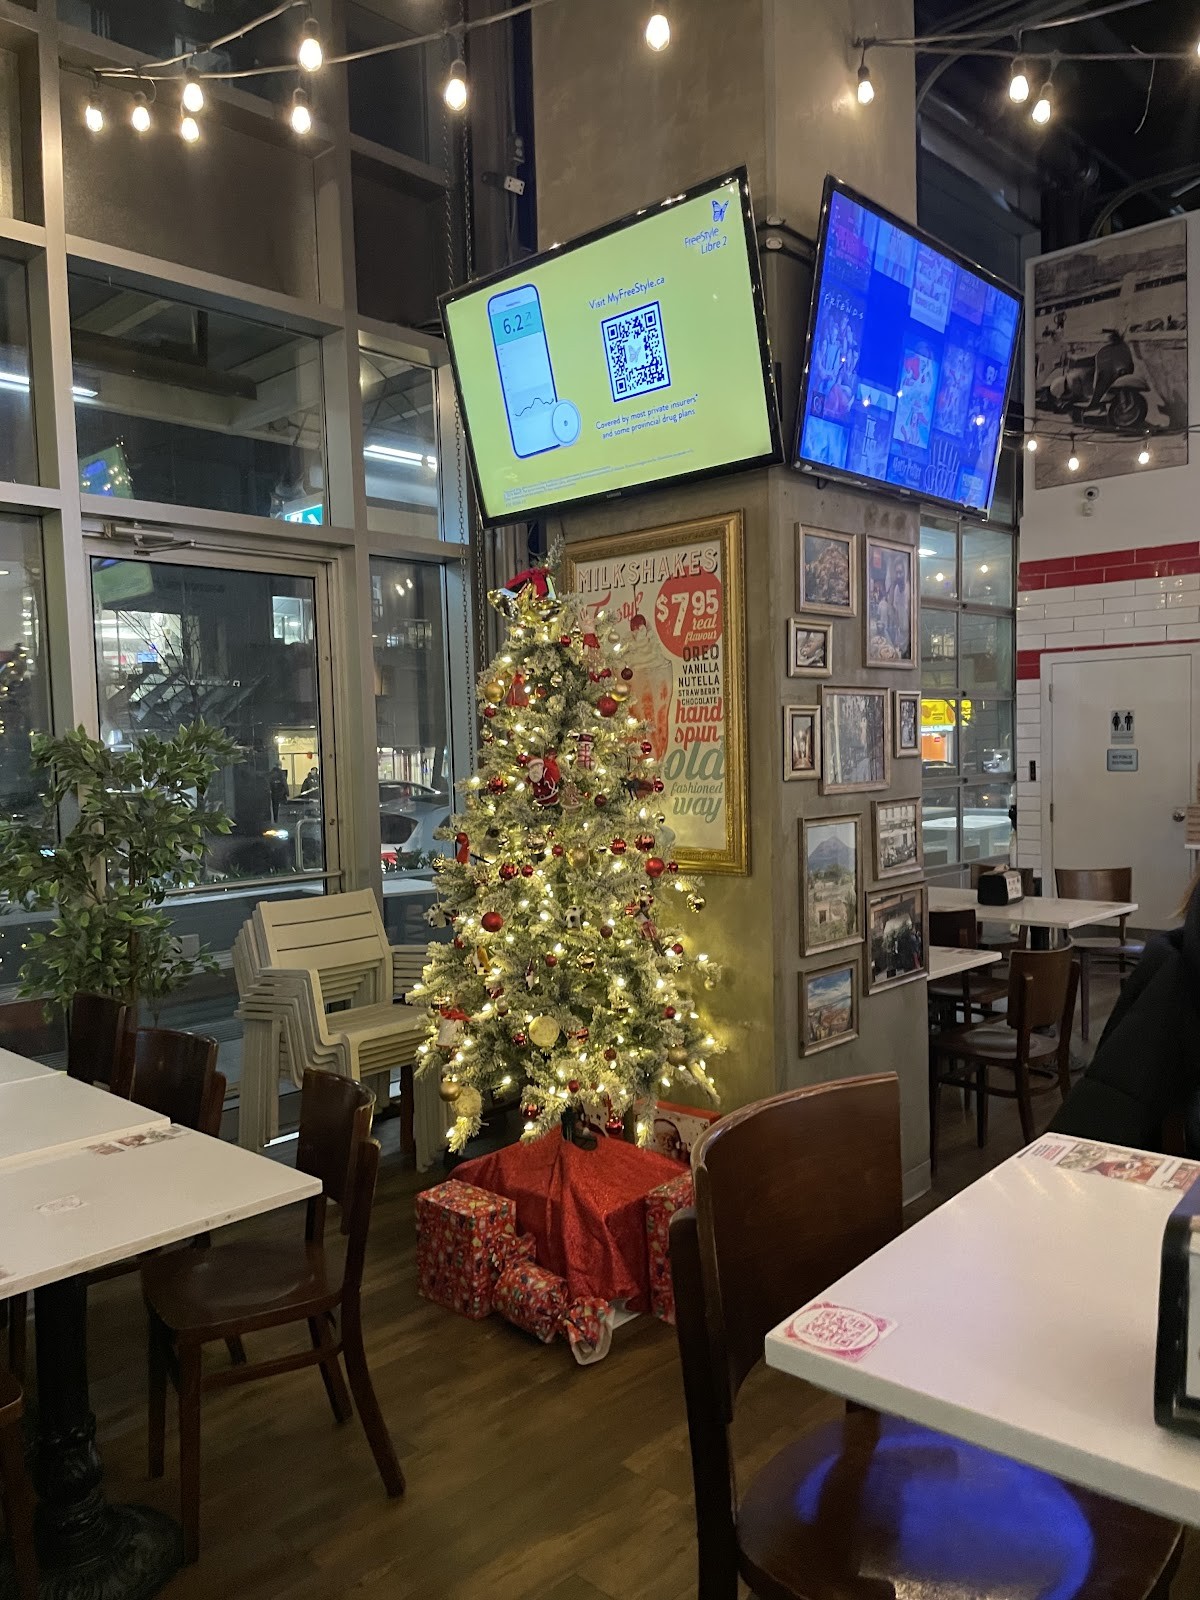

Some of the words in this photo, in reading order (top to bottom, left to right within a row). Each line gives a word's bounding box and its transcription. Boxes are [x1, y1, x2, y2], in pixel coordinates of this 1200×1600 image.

[684, 227, 719, 248] FreeStyle
[701, 240, 721, 255] Libre
[722, 235, 728, 246] 2
[588, 299, 606, 310] Visit
[607, 277, 666, 305] MyFreeStyle.ca
[503, 314, 524, 335] 6.2
[595, 415, 623, 430] Covered
[621, 414, 629, 424] by
[630, 411, 646, 420] most
[647, 404, 669, 416] private
[602, 430, 613, 440] and
[614, 426, 630, 437] some
[631, 417, 661, 434] provincial
[662, 414, 678, 424] drug
[678, 408, 696, 420] plans
[576, 548, 719, 594] MILKSHAKES
[692, 613, 717, 631] real
[684, 630, 718, 646] flavour
[682, 643, 720, 662] OREO
[682, 662, 720, 675] VANILLA
[678, 674, 720, 688] NUTELLA
[678, 687, 720, 697] STRAWBERRY
[681, 696, 718, 706] CHOCOLATE
[674, 696, 725, 724] hand
[674, 725, 721, 751] spun
[664, 734, 726, 781] old
[670, 782, 724, 796] fashioned
[672, 797, 724, 824] way
